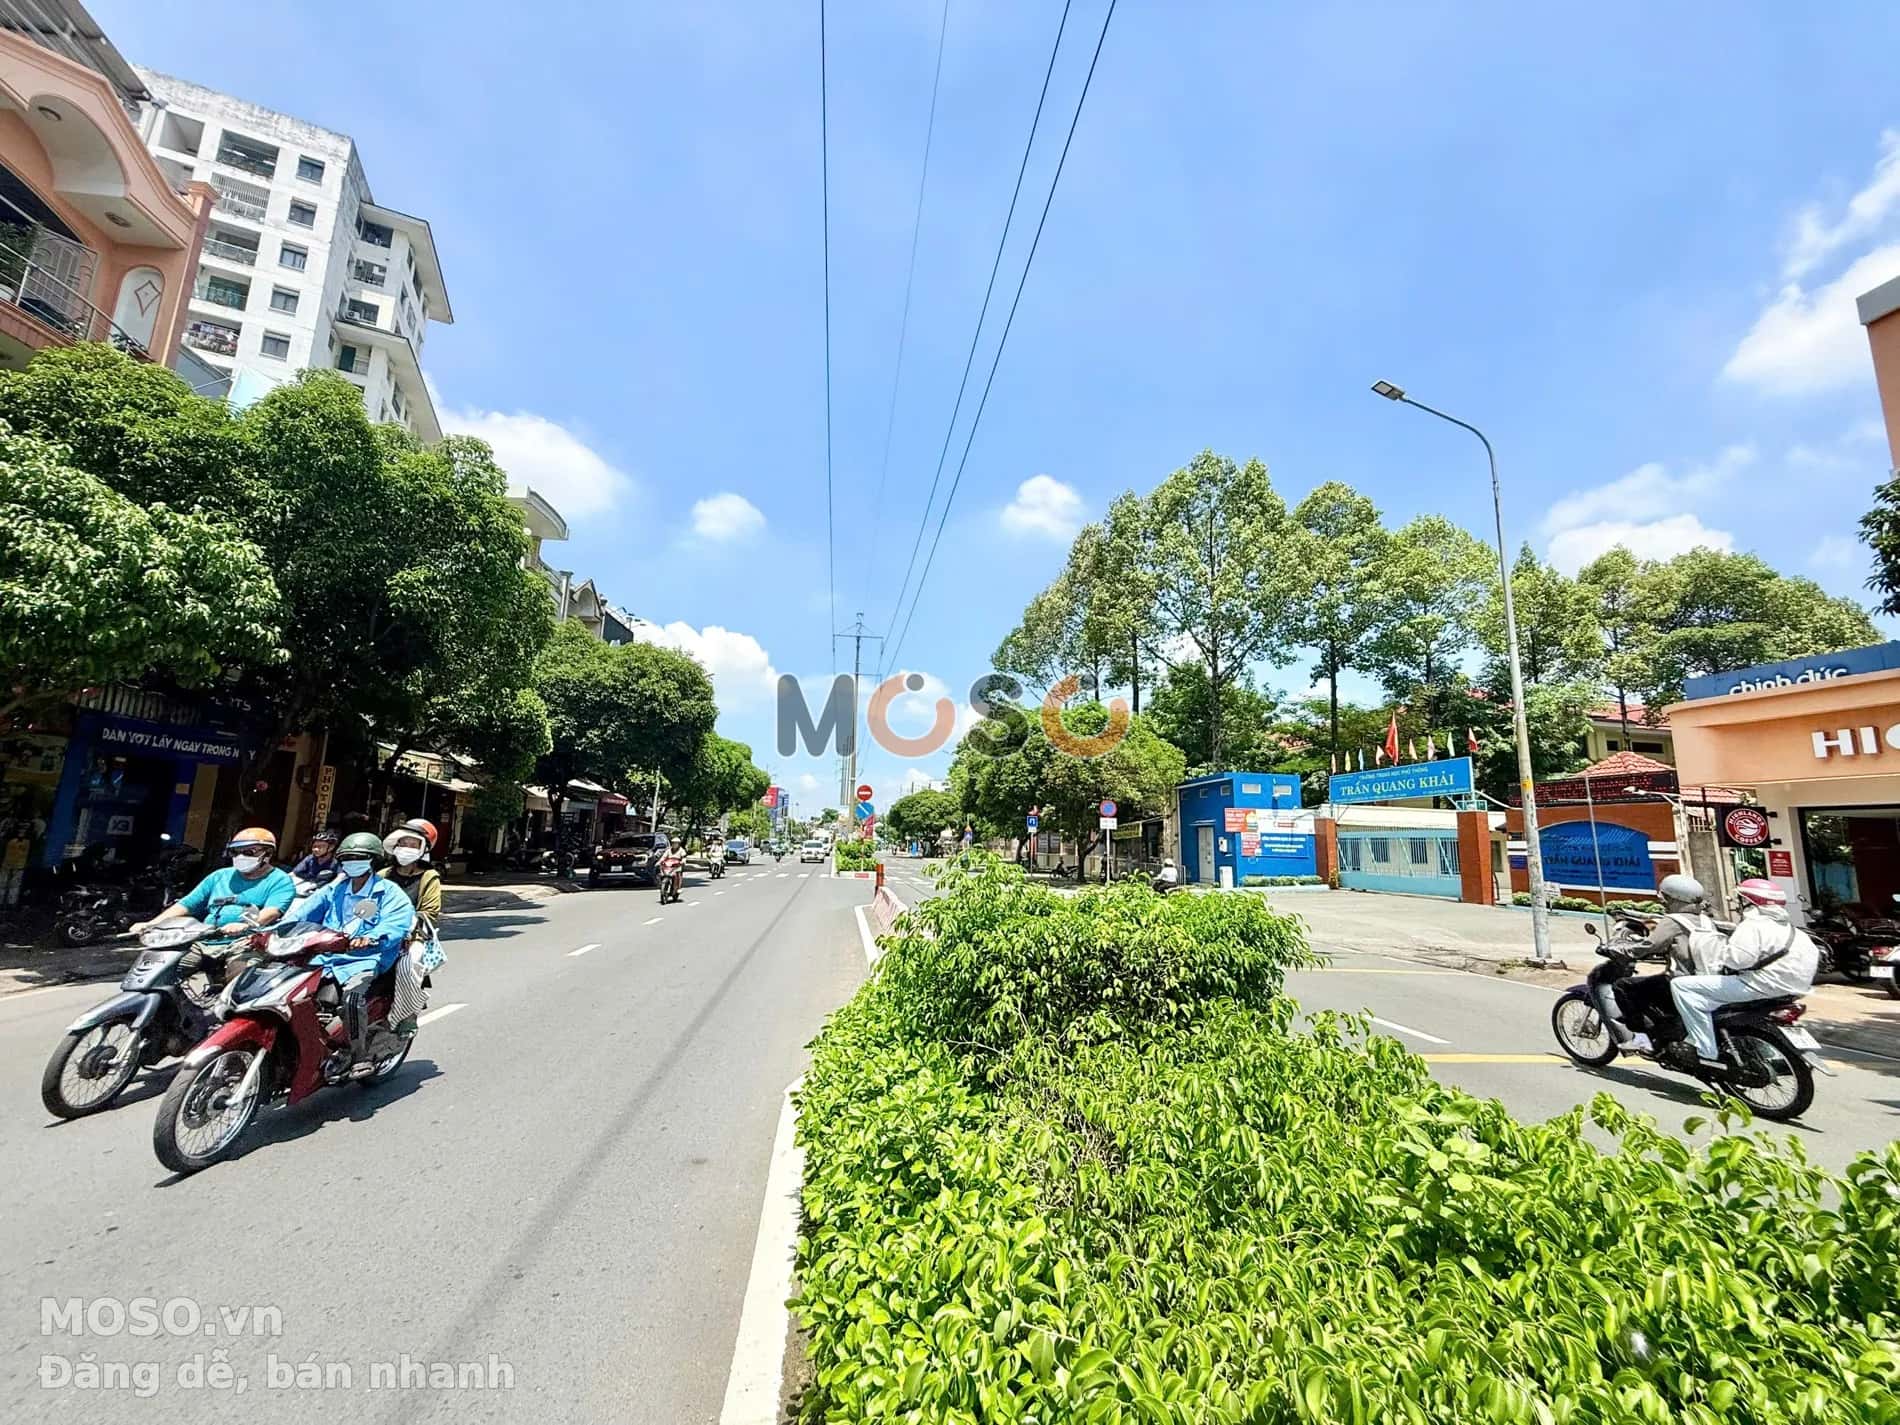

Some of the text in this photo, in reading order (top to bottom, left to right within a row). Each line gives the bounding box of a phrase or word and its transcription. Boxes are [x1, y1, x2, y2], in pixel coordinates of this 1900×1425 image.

[173, 739, 202, 754] NGAY
[1372, 779, 1416, 794] QUANG
[1419, 770, 1455, 789] KHẢI
